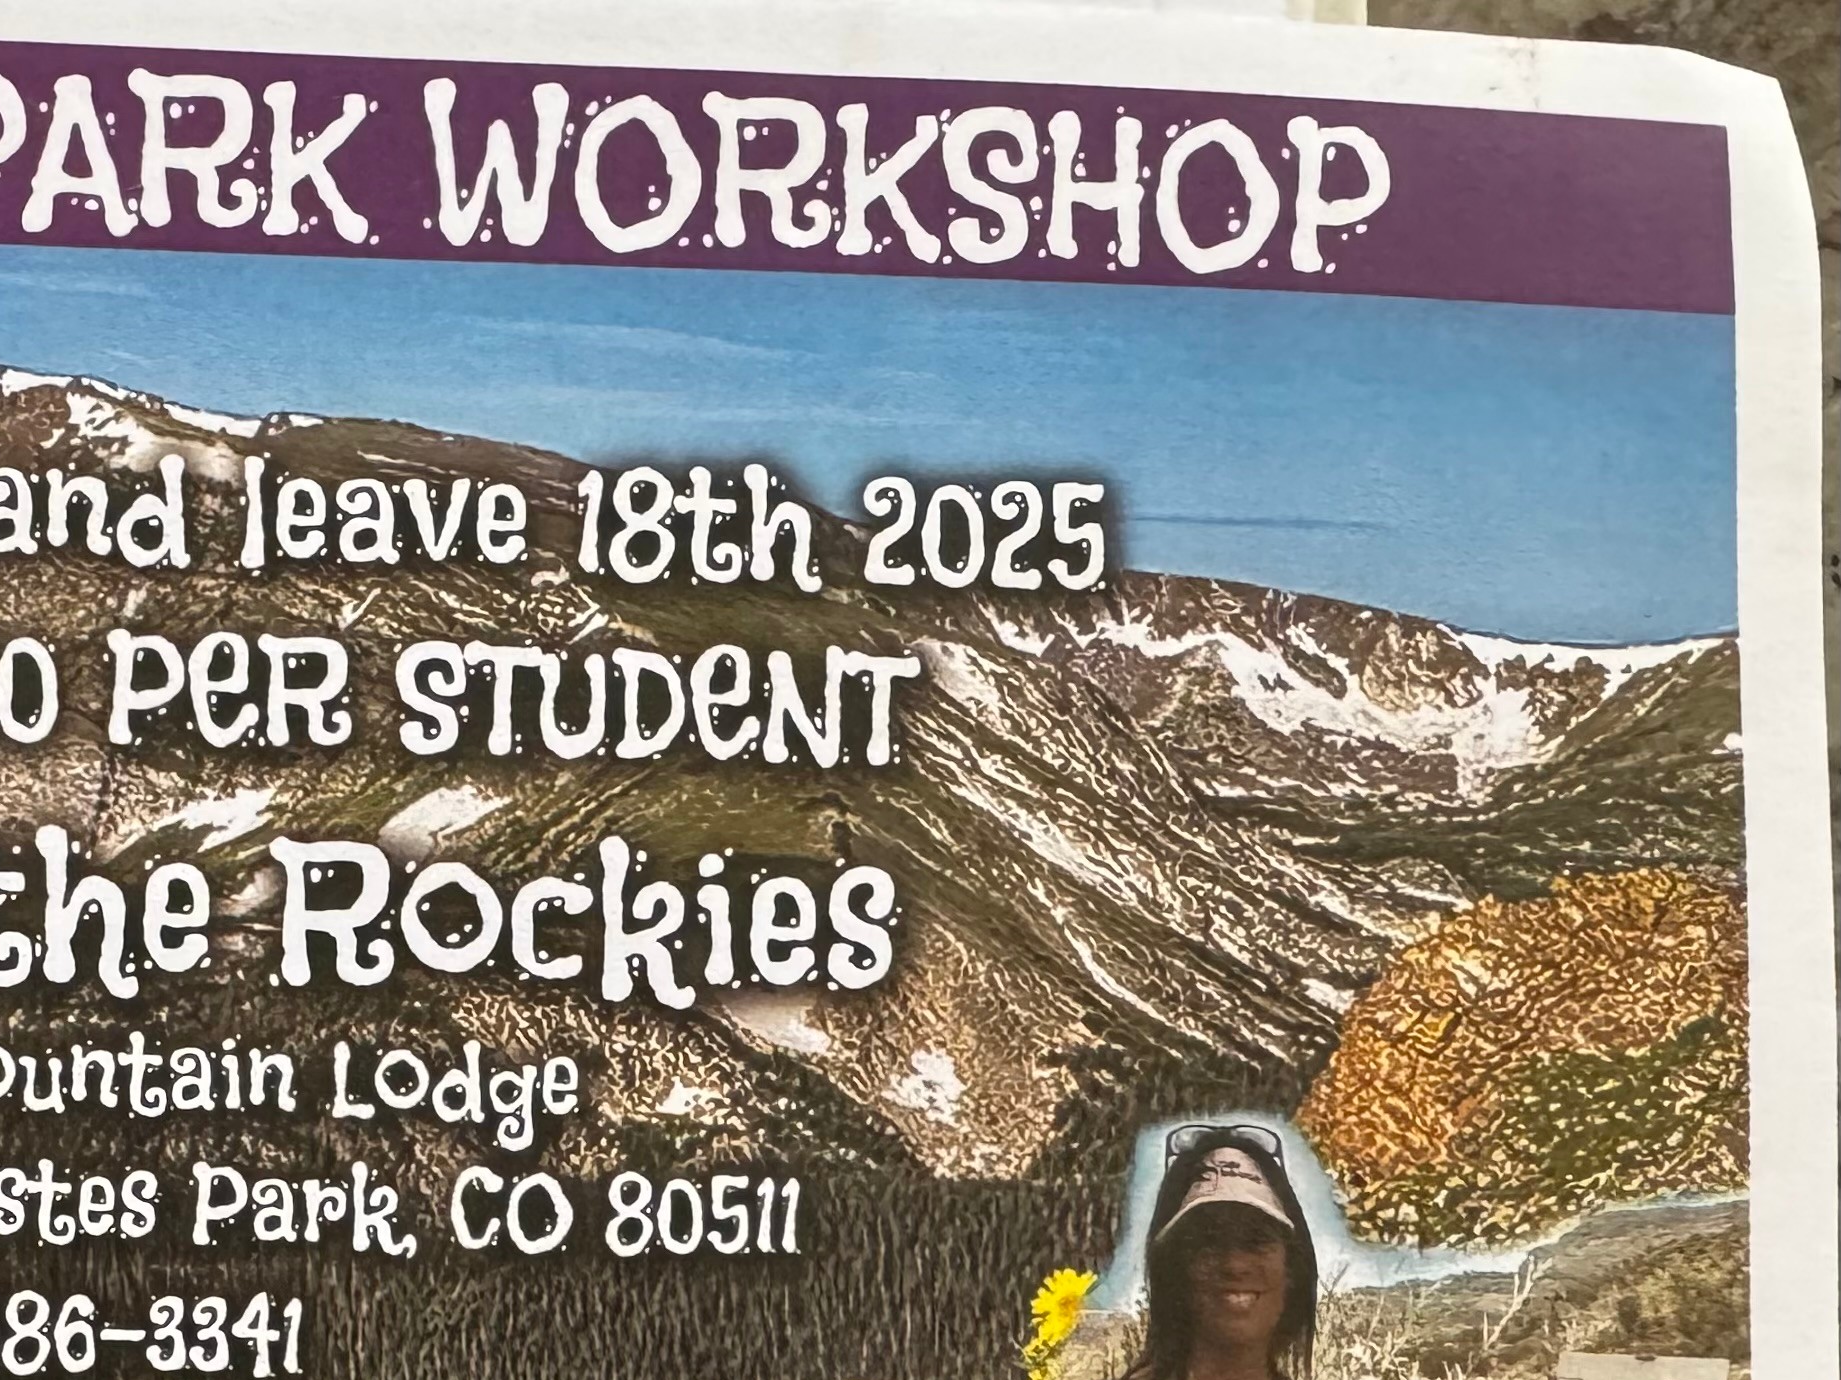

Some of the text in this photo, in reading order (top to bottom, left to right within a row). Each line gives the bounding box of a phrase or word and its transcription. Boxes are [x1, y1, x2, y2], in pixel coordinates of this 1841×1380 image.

[422, 78, 1390, 272] WORKSHOP
[241, 452, 526, 568] leave
[578, 464, 822, 592] 18th
[863, 477, 1104, 590] 2025
[270, 834, 899, 1010] Rockies
[332, 1040, 578, 1151] Lodge
[193, 1161, 416, 1258] Park,
[451, 1166, 573, 1254] CO
[606, 1171, 800, 1256] 80511
